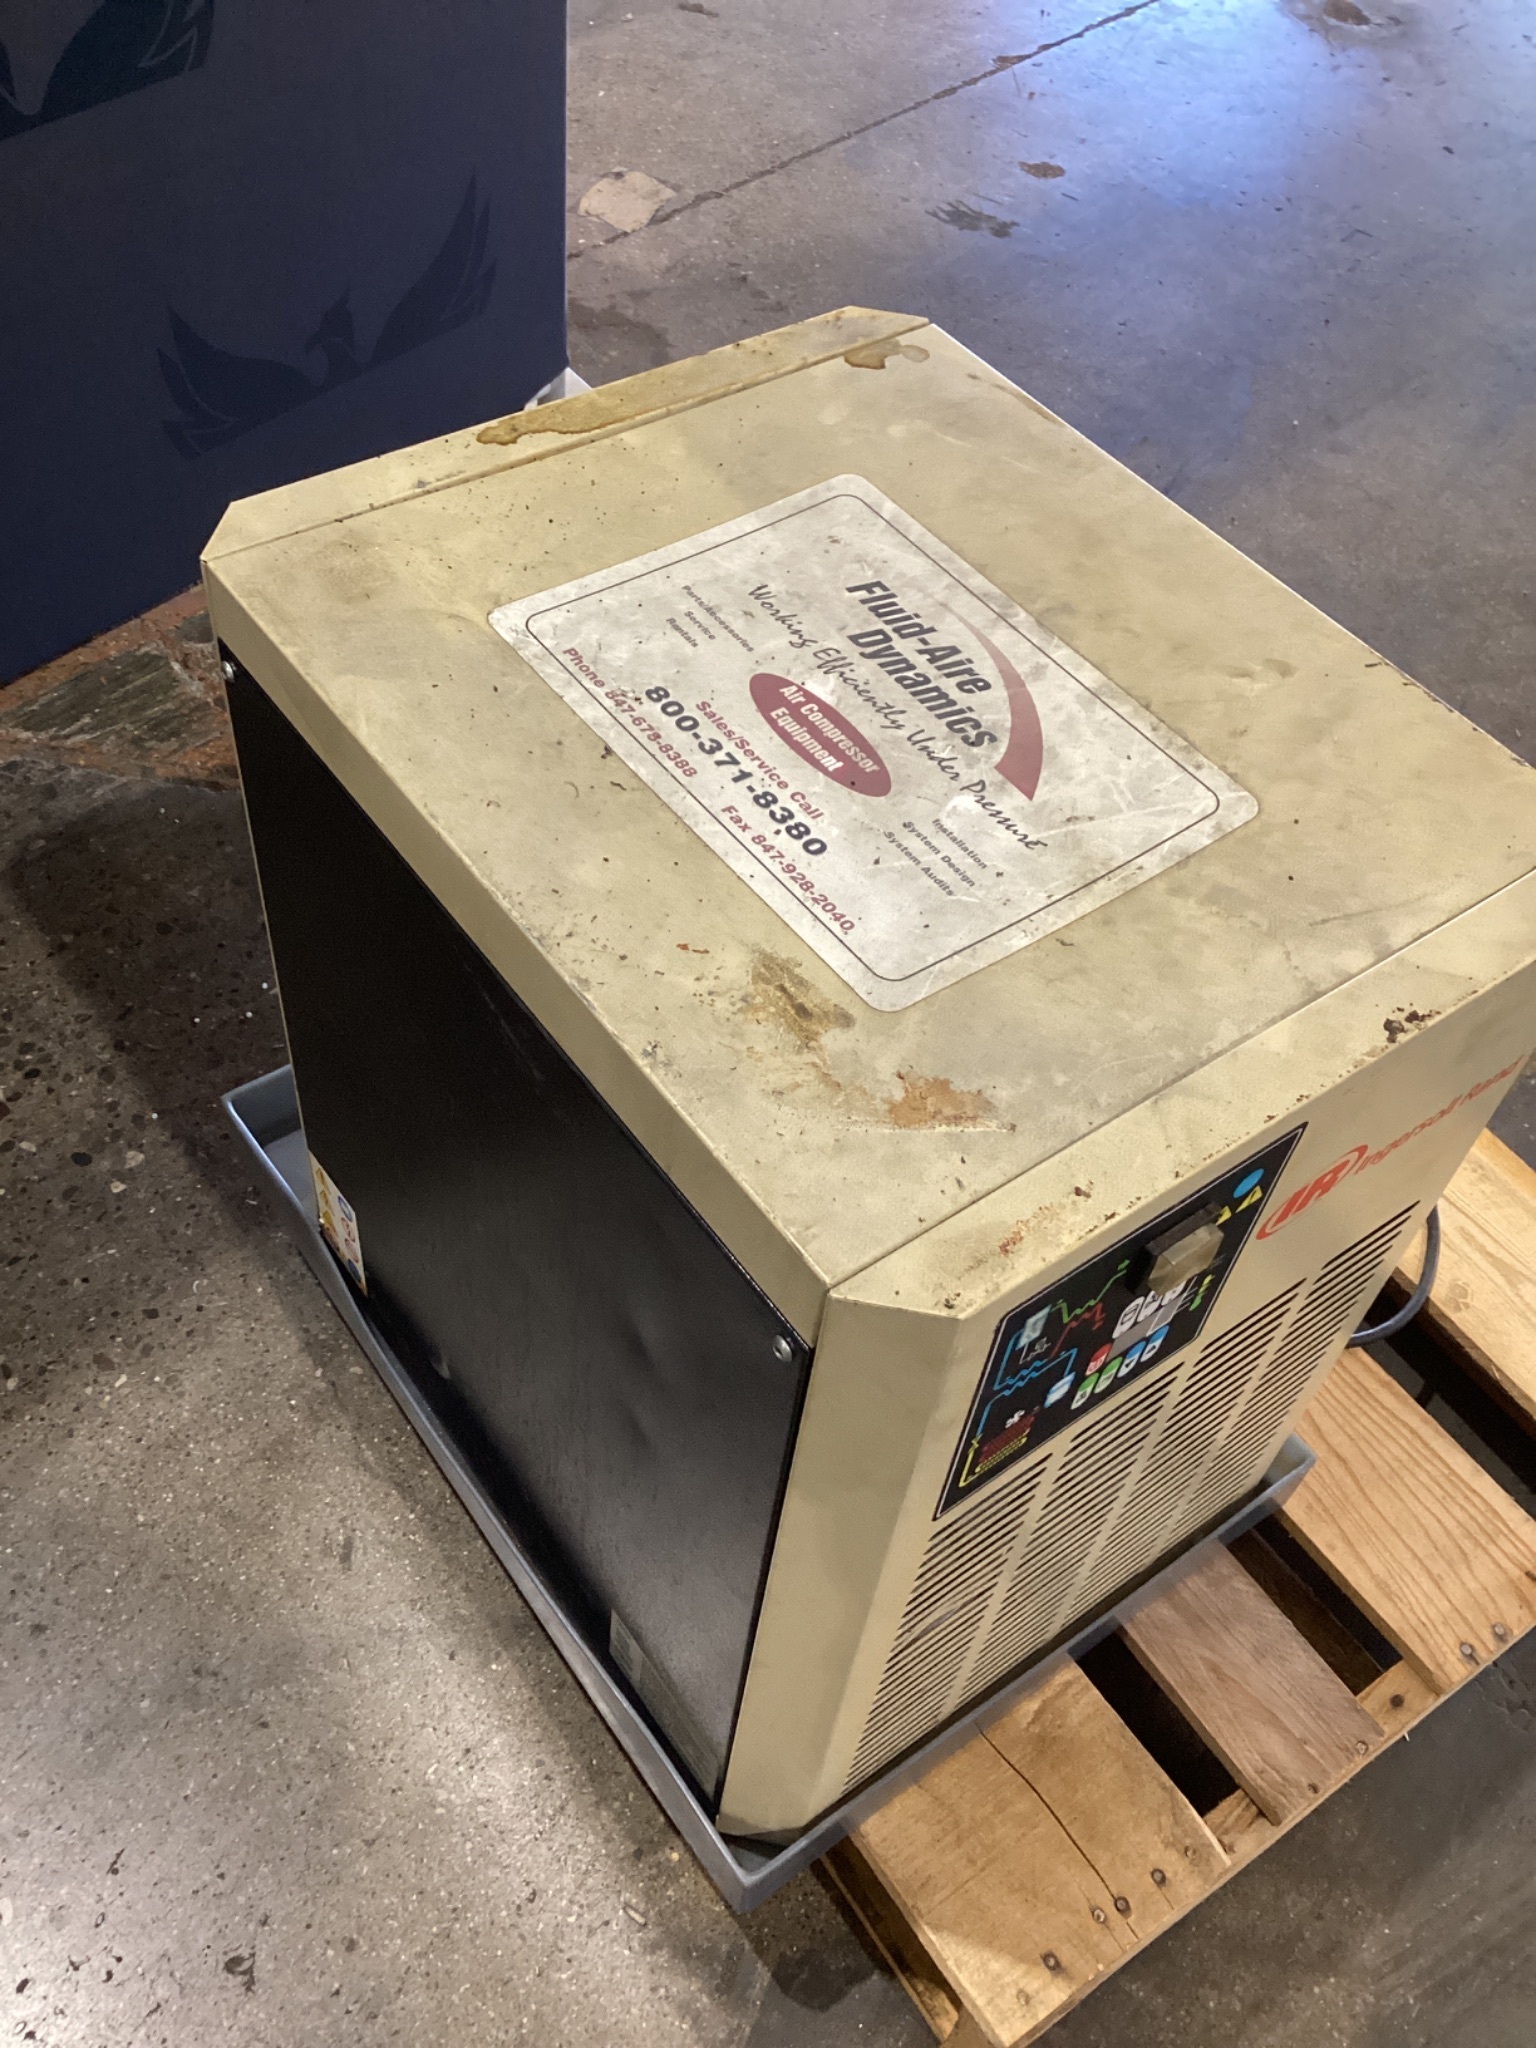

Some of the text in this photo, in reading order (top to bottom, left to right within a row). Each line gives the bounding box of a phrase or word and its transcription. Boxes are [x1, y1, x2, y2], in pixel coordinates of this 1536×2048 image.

[666, 617, 698, 648] Rentals
[682, 585, 754, 652] Parts/Accessories
[684, 611, 716, 641] Service
[845, 580, 992, 694] Fluid-Aire
[562, 647, 698, 778] Phone 847-678-8388
[748, 584, 1048, 850] Working Efficiently Under Pressure
[779, 684, 880, 773] Air Compressor
[846, 628, 998, 747] Dynamics
[645, 686, 827, 855] 800-371-8380
[696, 701, 824, 820] Sales/Service Call
[770, 707, 844, 772] Equipment
[721, 805, 855, 931] Fax 847-928-2040
[884, 831, 954, 896] System Audits
[903, 821, 975, 887] System Design
[932, 818, 987, 869] Installation
